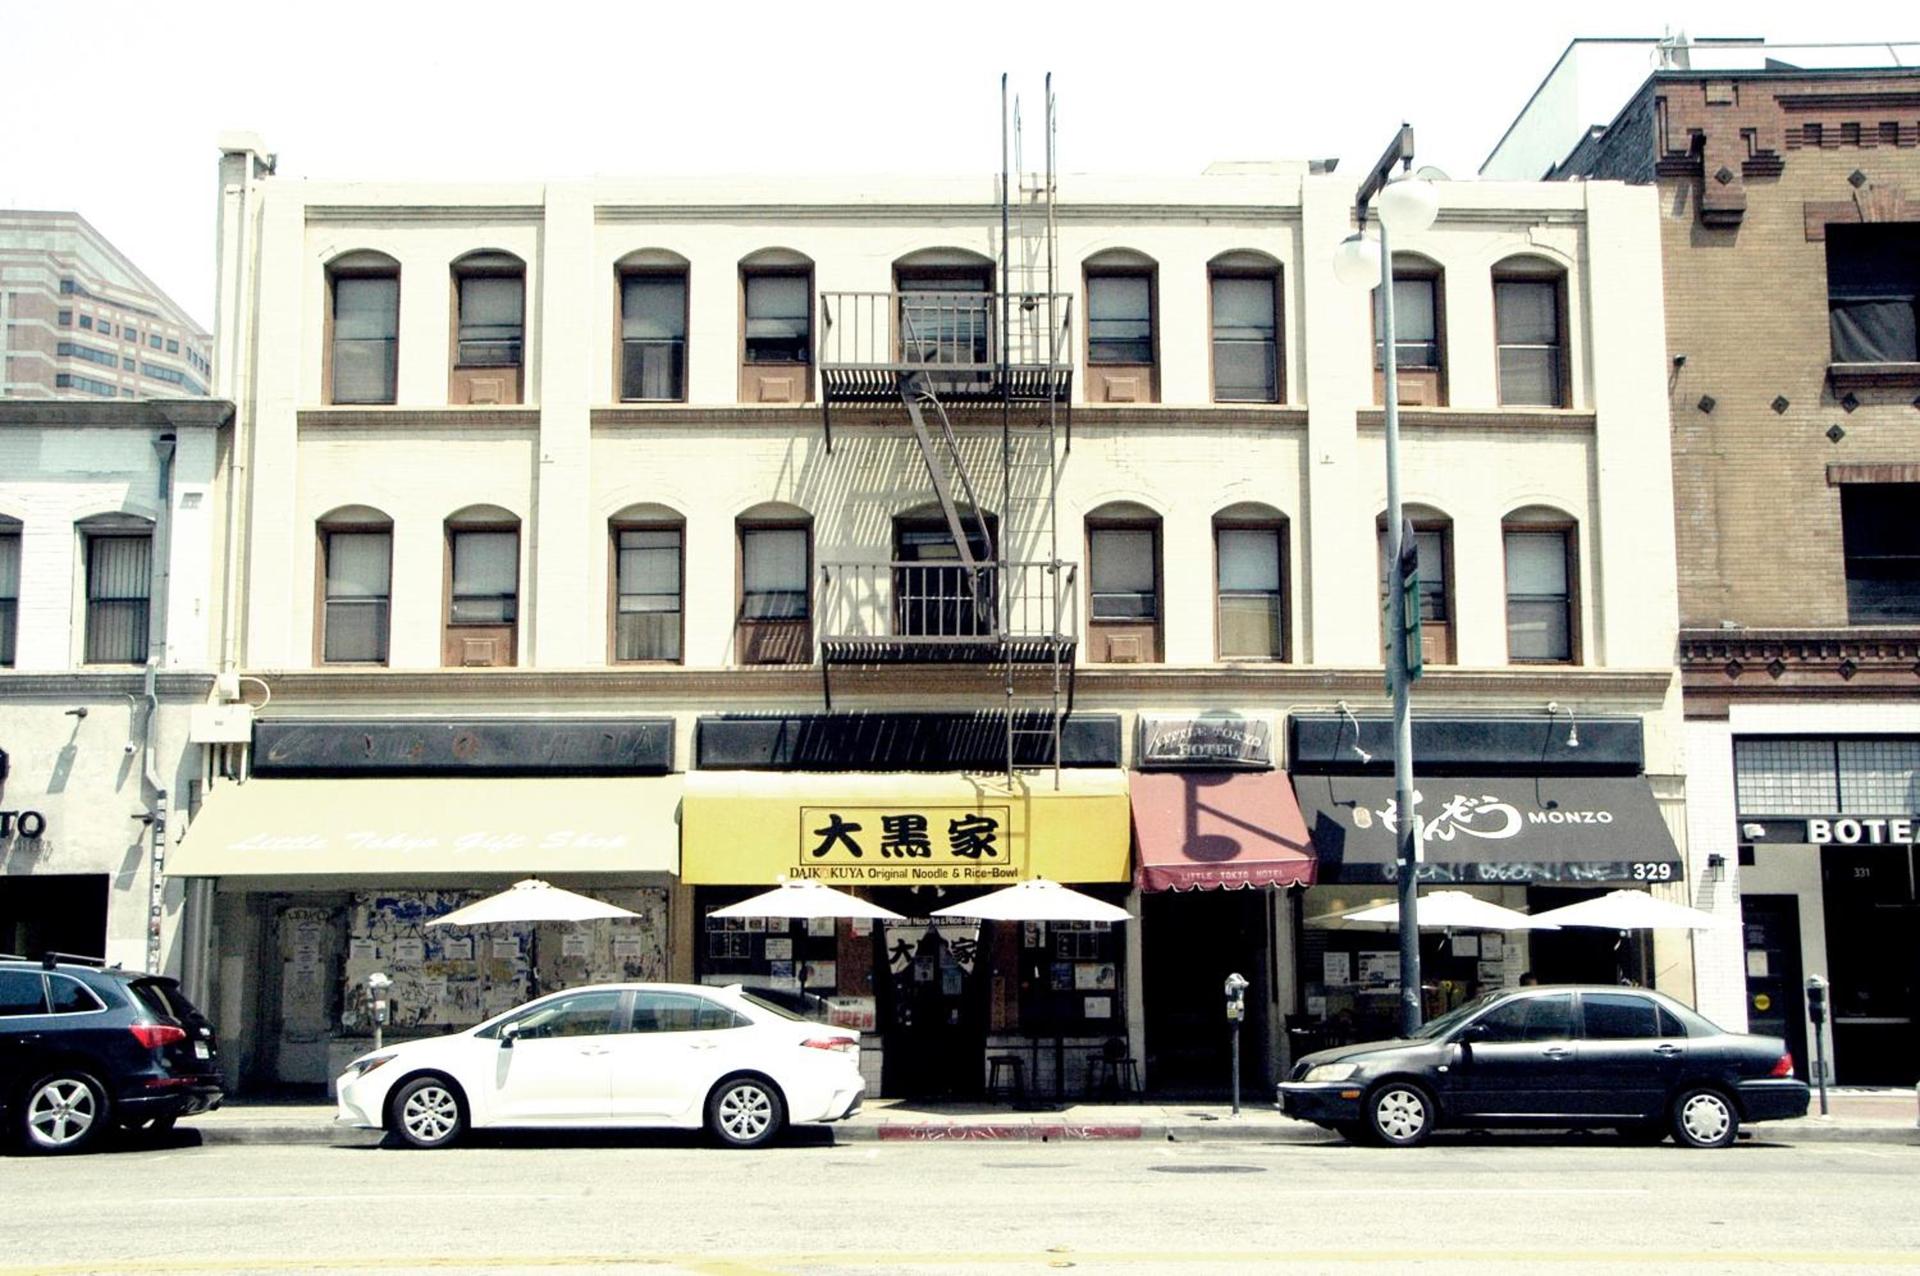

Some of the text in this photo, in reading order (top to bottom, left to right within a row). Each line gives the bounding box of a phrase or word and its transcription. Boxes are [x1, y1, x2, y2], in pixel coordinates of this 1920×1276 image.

[1179, 743, 1238, 756] HOTEL
[1528, 810, 1614, 824] MONZO
[812, 813, 999, 859] 大黒家
[1807, 819, 1920, 844] BOTE
[868, 868, 908, 881] Original
[912, 868, 949, 879] Noodle
[952, 869, 960, 879] &
[964, 867, 1018, 879] Rice-Bowl
[1181, 869, 1283, 881] LITTLE TOKYO HOTEL
[1633, 863, 1672, 881] 329
[1854, 867, 1871, 878] 331
